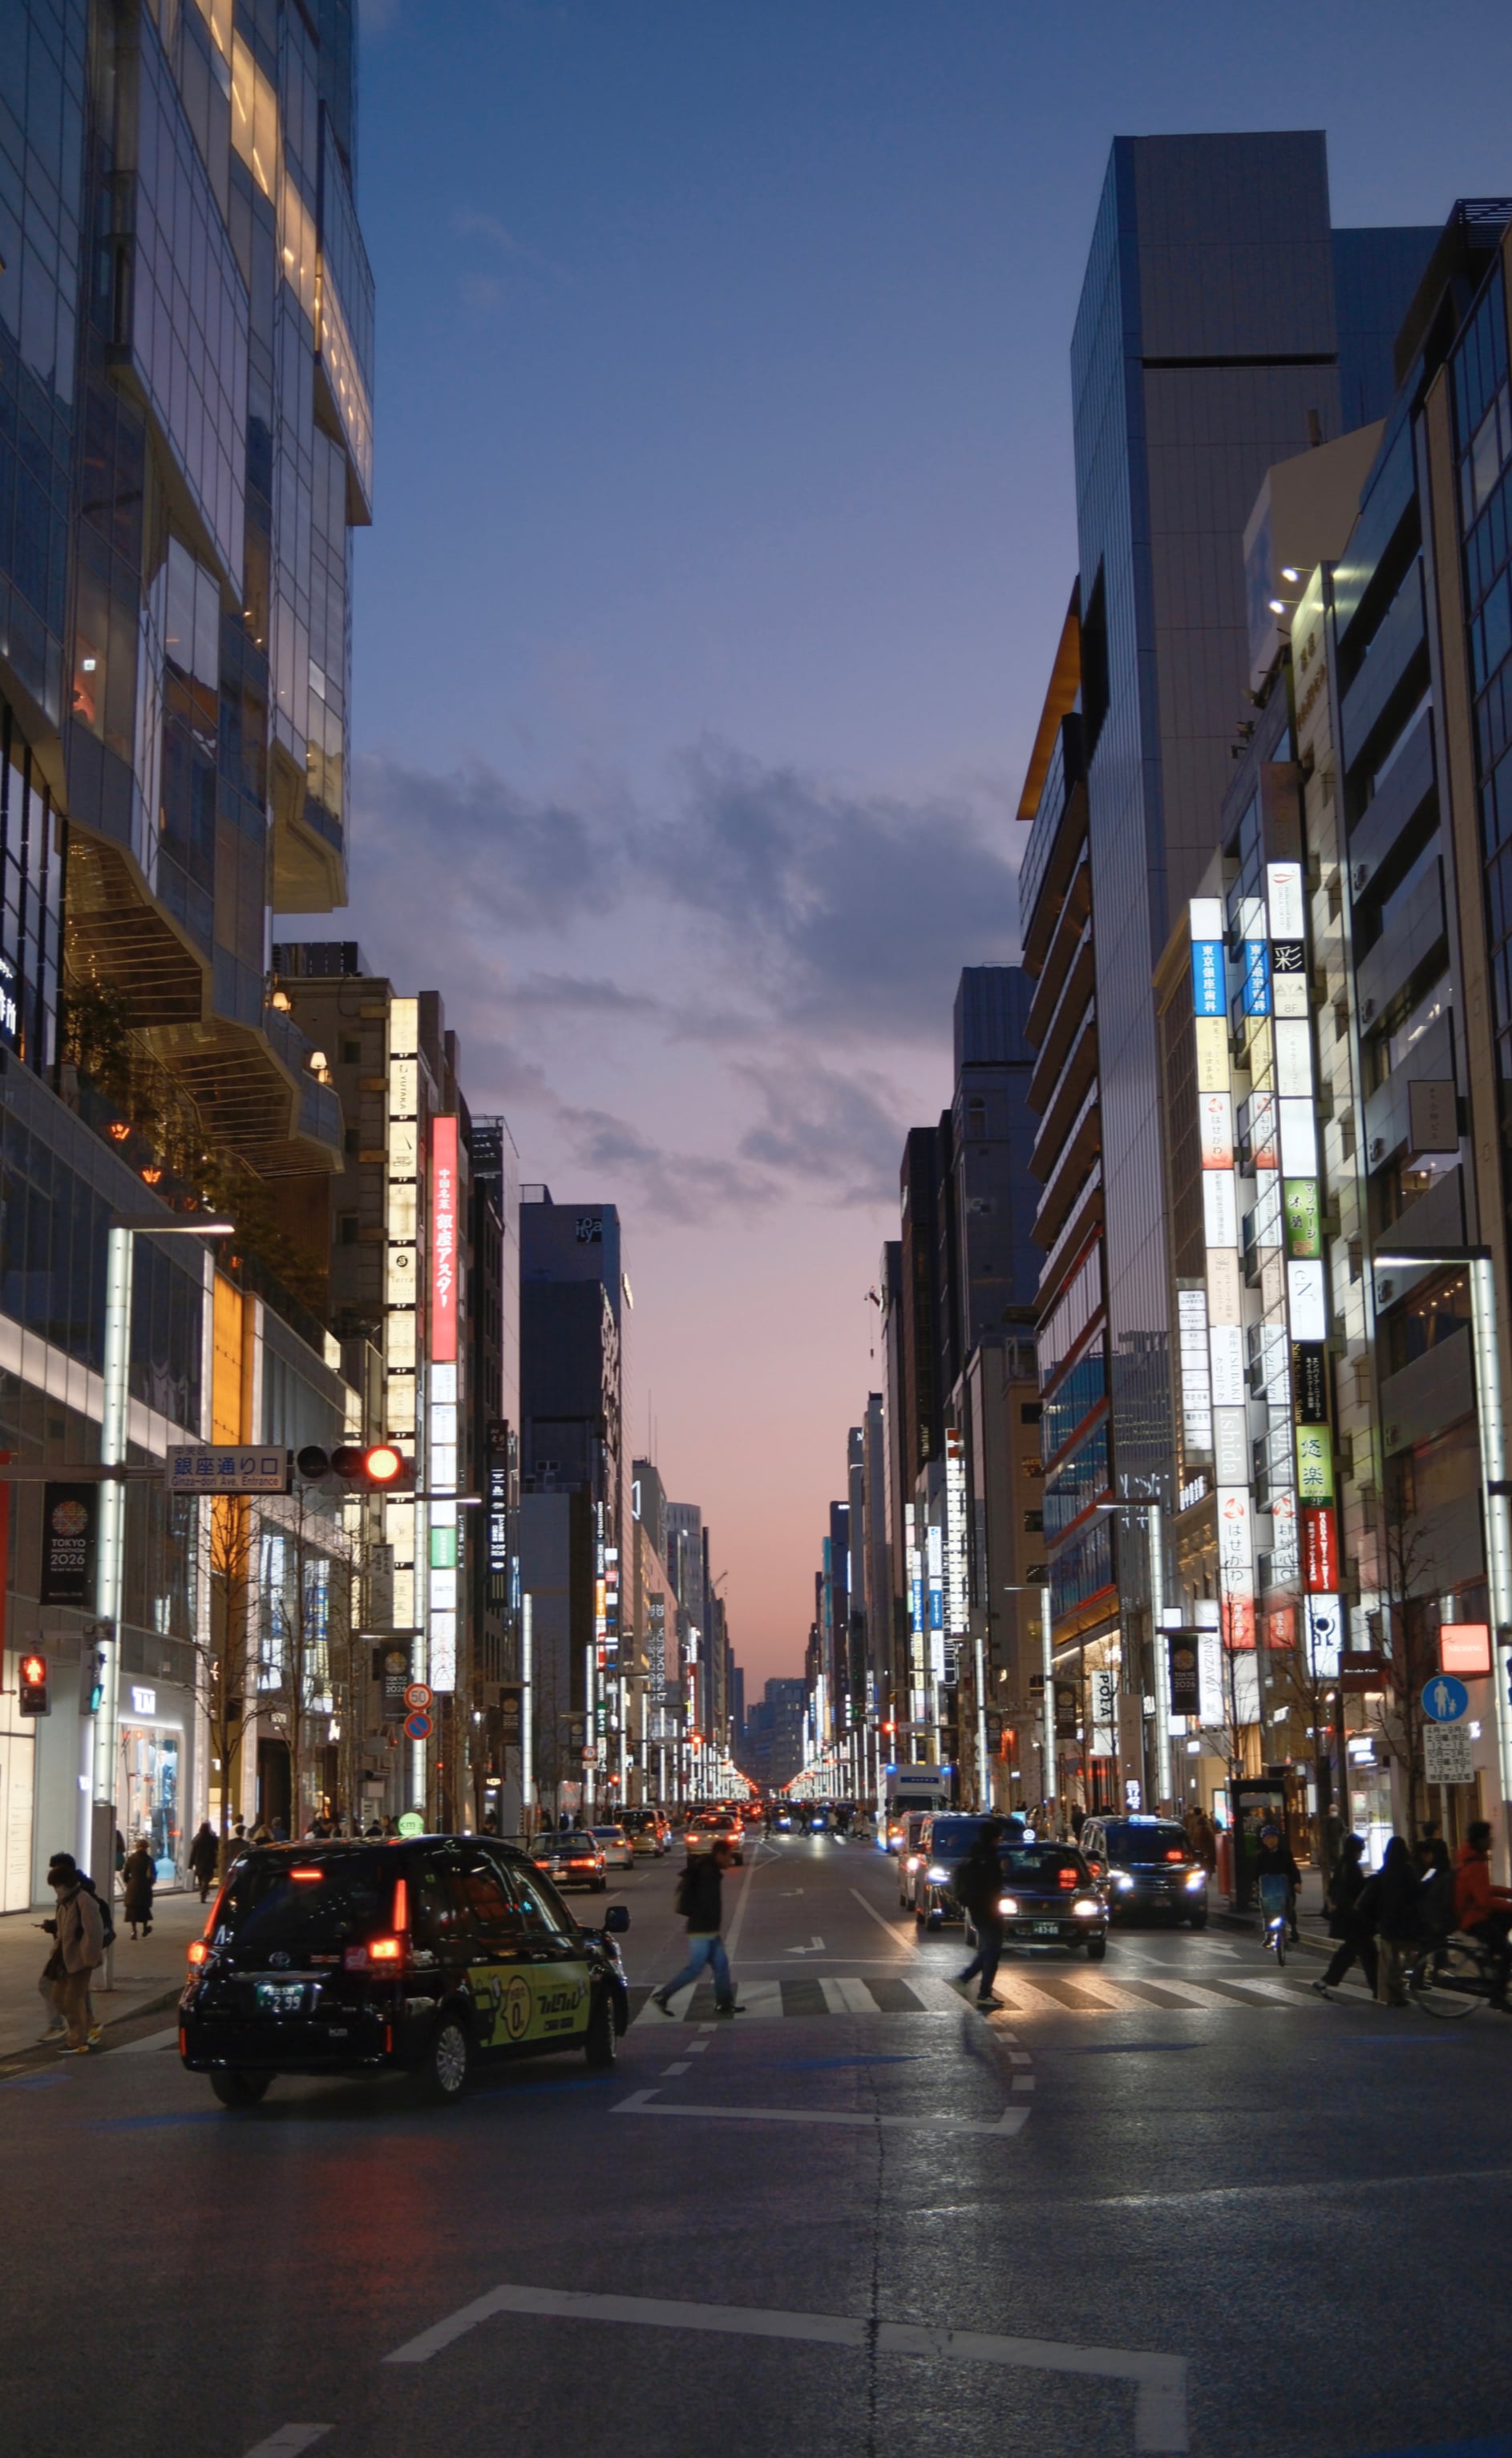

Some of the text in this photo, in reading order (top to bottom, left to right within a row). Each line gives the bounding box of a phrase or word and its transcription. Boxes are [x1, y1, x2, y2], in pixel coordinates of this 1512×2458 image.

[1275, 946, 1302, 971] 彩
[1202, 945, 1217, 1012] 東京銀座歯科
[1275, 984, 1305, 993] AYA
[1284, 1004, 1297, 1013] 8F
[1211, 1115, 1223, 1154] はせがわ
[438, 1168, 451, 1209] 中国名菜
[1304, 1183, 1316, 1239] マッサージ
[435, 1213, 454, 1308] 銀座アスター
[1216, 1356, 1225, 1400] クリニック
[174, 1446, 207, 1456] 中央区
[1219, 1410, 1239, 1474] Ishida
[174, 1457, 277, 1475] 銀座通り口
[1301, 1439, 1324, 1486] 悠楽
[172, 1476, 217, 1486] Ginza-dori
[242, 1476, 279, 1486] Entrance
[1311, 1497, 1324, 1506] 2F
[51, 1539, 87, 1547] TOKYO
[1227, 1523, 1244, 1582] はせがわ
[51, 1554, 85, 1565] 2026
[1203, 1636, 1216, 1693] ANIZAWA
[1099, 1674, 1113, 1717] POLA
[1174, 1680, 1196, 1688] 2026
[411, 1690, 427, 1704] 50
[1127, 1788, 1140, 1797] 17
